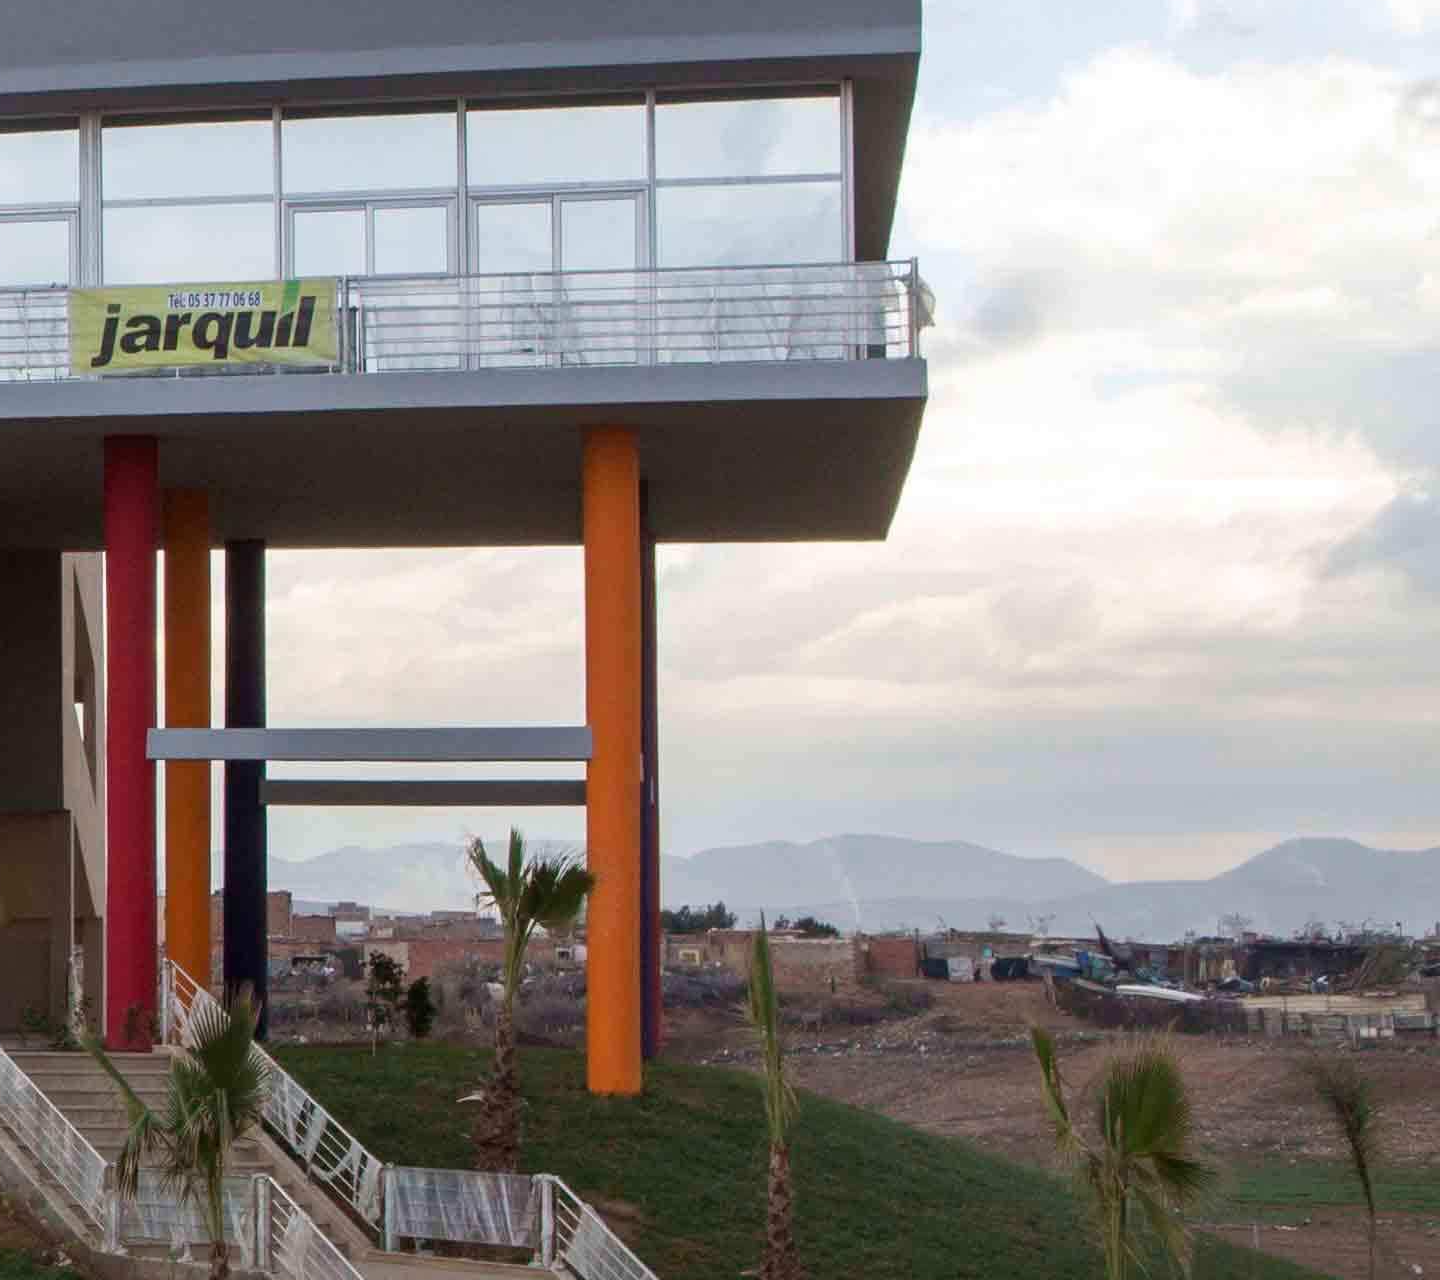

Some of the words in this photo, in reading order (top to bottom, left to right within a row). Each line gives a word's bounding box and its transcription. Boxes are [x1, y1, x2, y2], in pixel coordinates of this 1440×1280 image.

[188, 294, 200, 307] 05
[203, 293, 215, 307] 37
[219, 293, 231, 306] 77
[233, 292, 245, 306] 06
[248, 291, 260, 305] 68
[91, 295, 316, 367] jarquil
